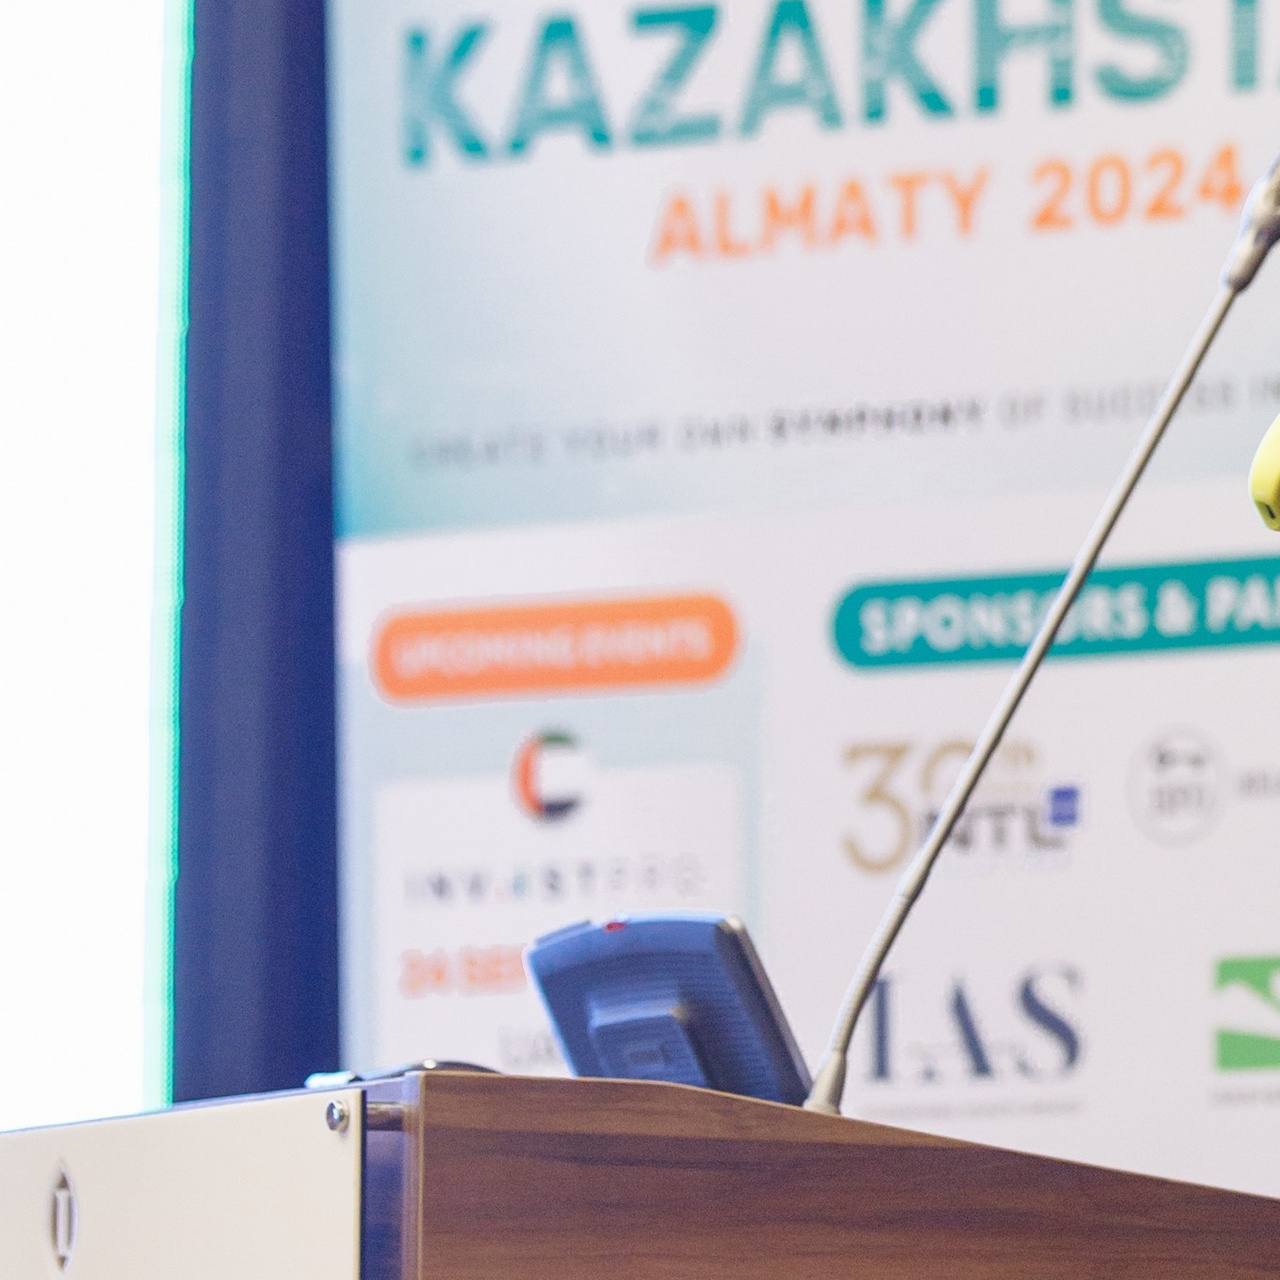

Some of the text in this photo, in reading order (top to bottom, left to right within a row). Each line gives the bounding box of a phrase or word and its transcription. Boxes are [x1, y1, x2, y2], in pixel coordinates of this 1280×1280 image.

[652, 140, 1246, 266] ALMATY 2024
[1152, 578, 1200, 638] &
